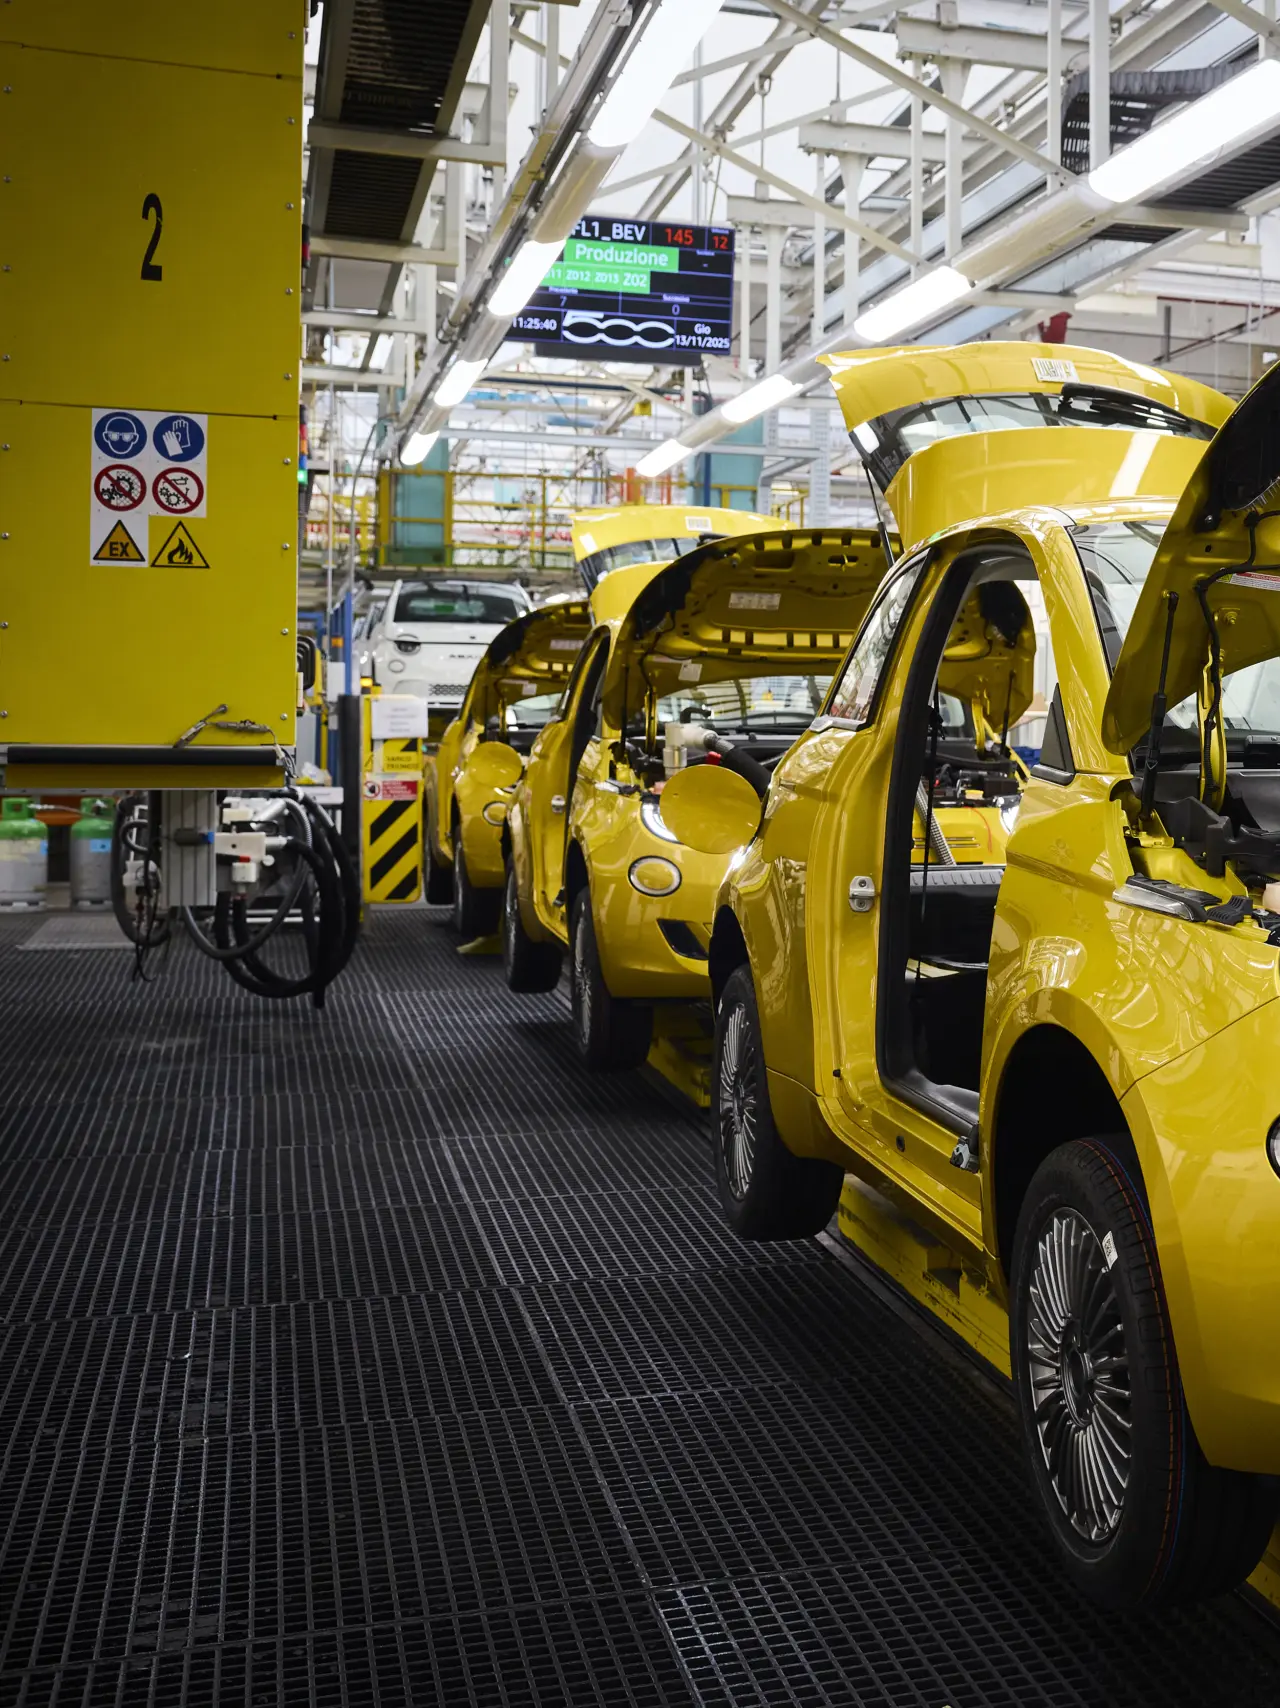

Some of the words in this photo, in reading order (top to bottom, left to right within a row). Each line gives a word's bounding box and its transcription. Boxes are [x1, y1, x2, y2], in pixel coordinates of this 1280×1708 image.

[141, 193, 163, 281] 2
[665, 228, 693, 245] 145
[712, 235, 728, 249] 12
[575, 244, 669, 267] Produzione
[672, 304, 680, 315] 0
[562, 310, 675, 348] 500
[694, 323, 711, 335] Gio
[675, 334, 730, 349] 13/11/2025
[109, 541, 130, 557] EX
